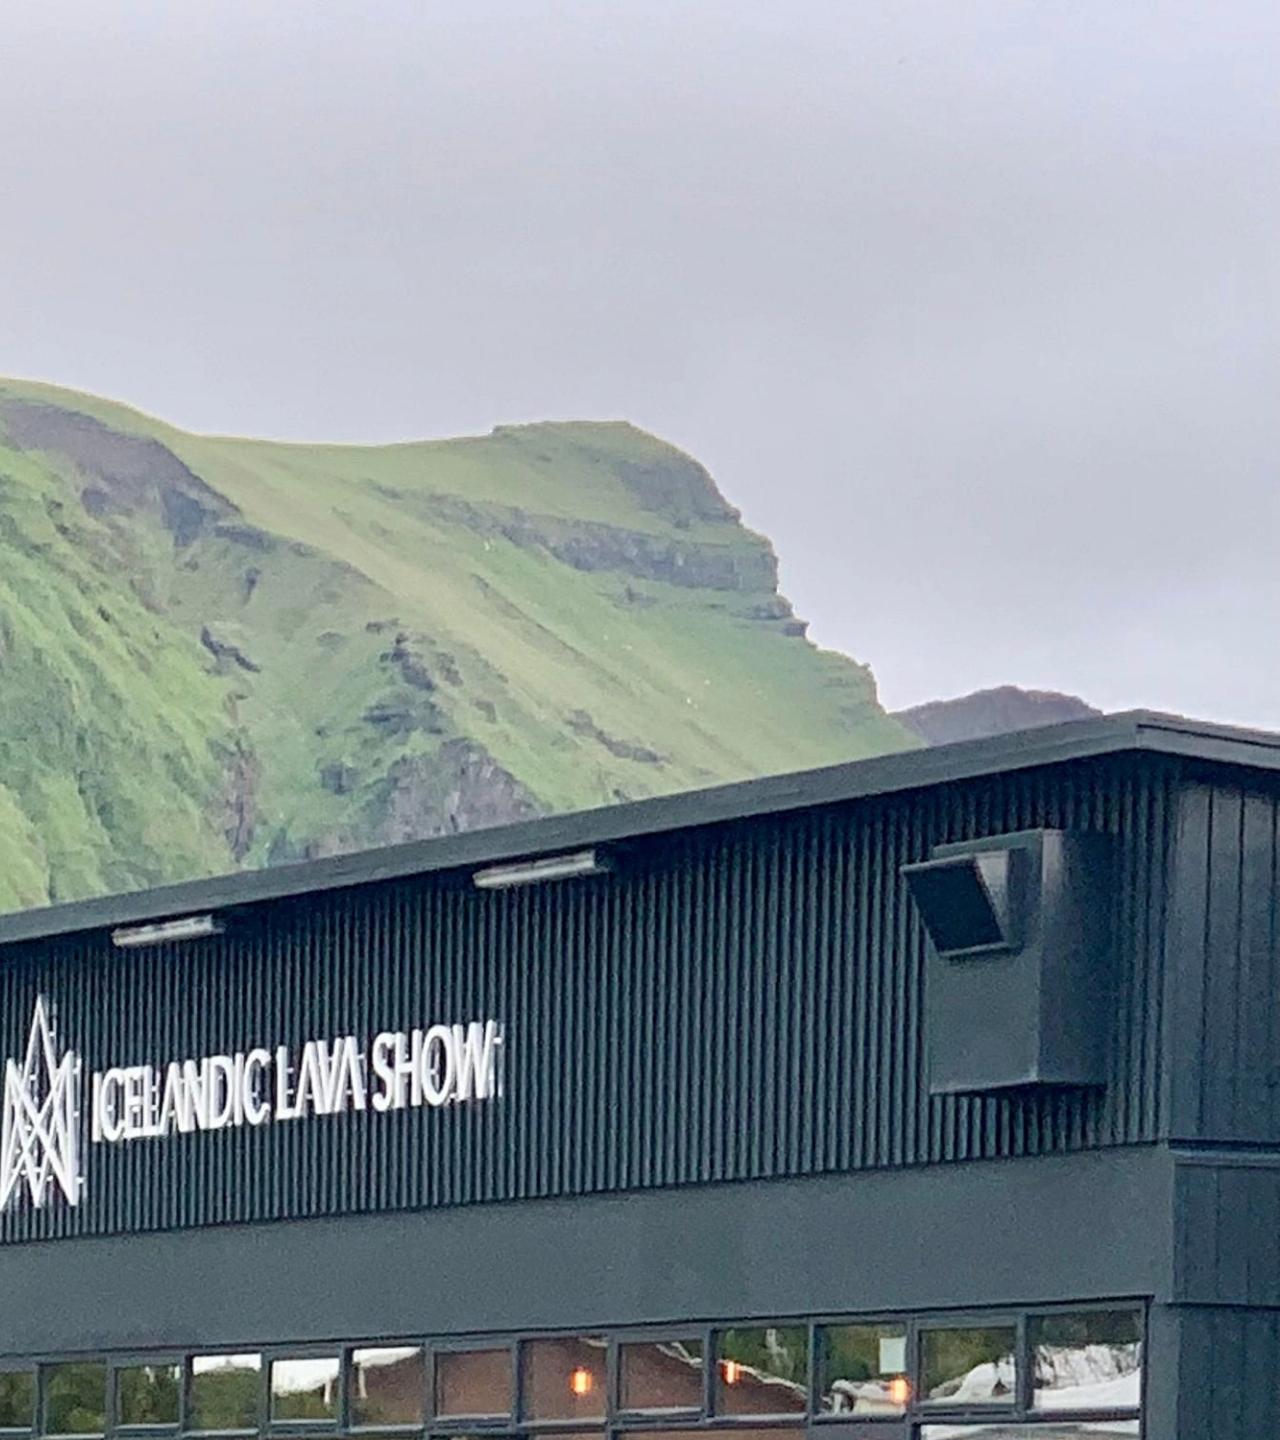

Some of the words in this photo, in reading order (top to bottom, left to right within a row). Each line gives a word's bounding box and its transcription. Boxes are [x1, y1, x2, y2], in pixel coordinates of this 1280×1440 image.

[91, 1047, 272, 1142] ICELANDIC
[275, 1035, 367, 1121] LAVA
[371, 1019, 498, 1112] SHOW
